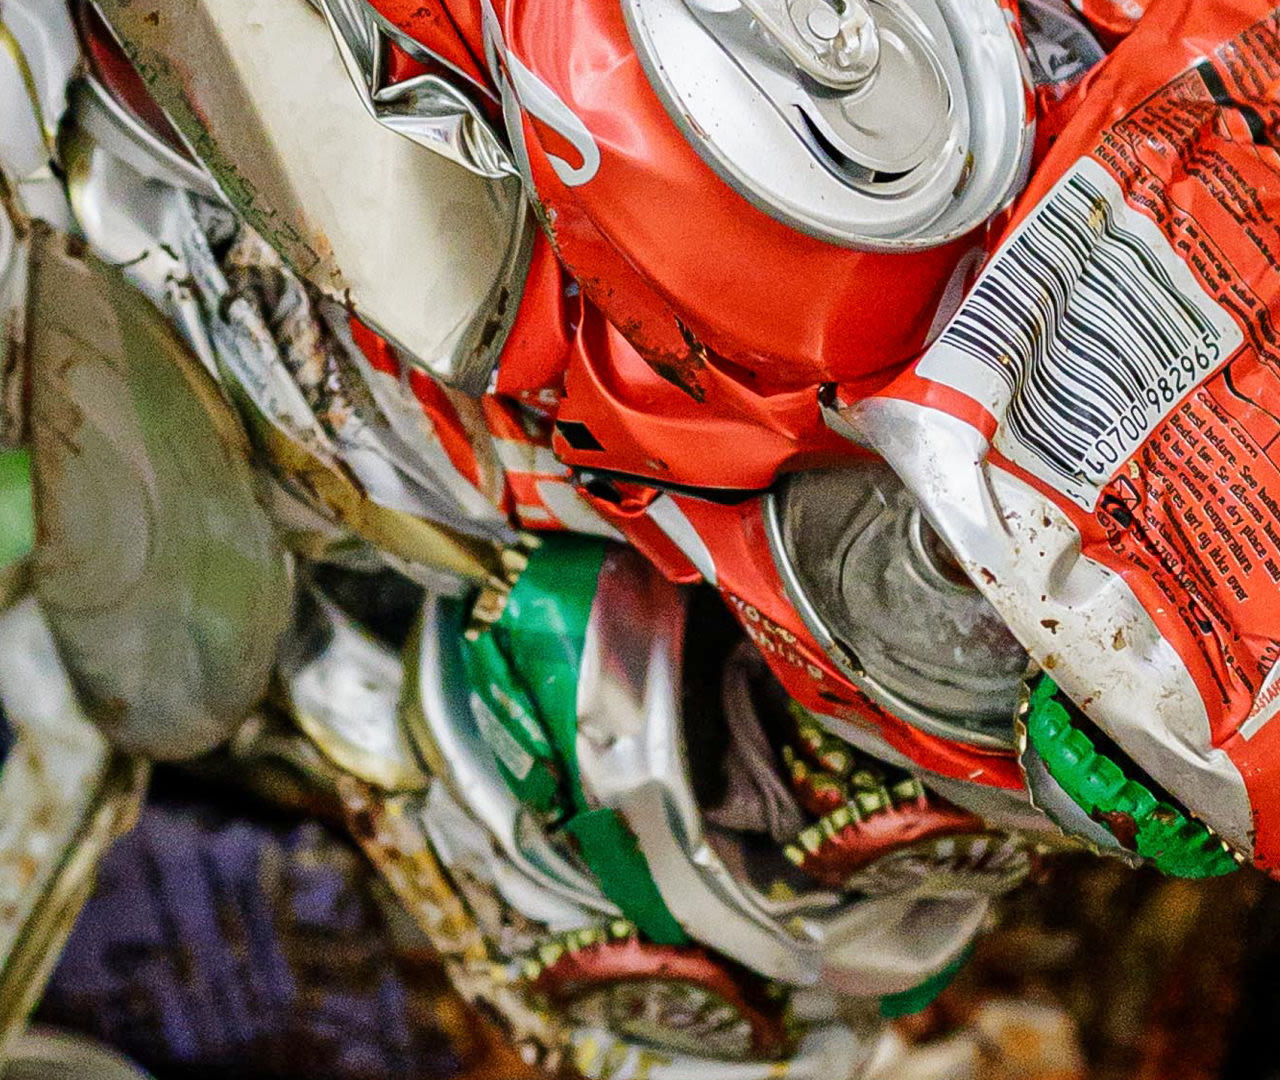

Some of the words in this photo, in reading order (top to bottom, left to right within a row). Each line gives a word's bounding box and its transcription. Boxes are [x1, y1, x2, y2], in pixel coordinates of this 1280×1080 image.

[1142, 333, 1223, 413] 982965
[1168, 412, 1200, 448] Bedst
[1227, 481, 1267, 527] dåsens
[1179, 401, 1206, 431] Best
[1236, 464, 1261, 491] See
[1195, 389, 1260, 460] coke.com
[1176, 469, 1206, 503] room
[1198, 499, 1259, 577] temperature.
[1179, 456, 1208, 487] kept
[1221, 502, 1246, 528] dry
[1237, 525, 1269, 560] place
[1206, 545, 1234, 575] ikke
[1224, 574, 1250, 603] over
